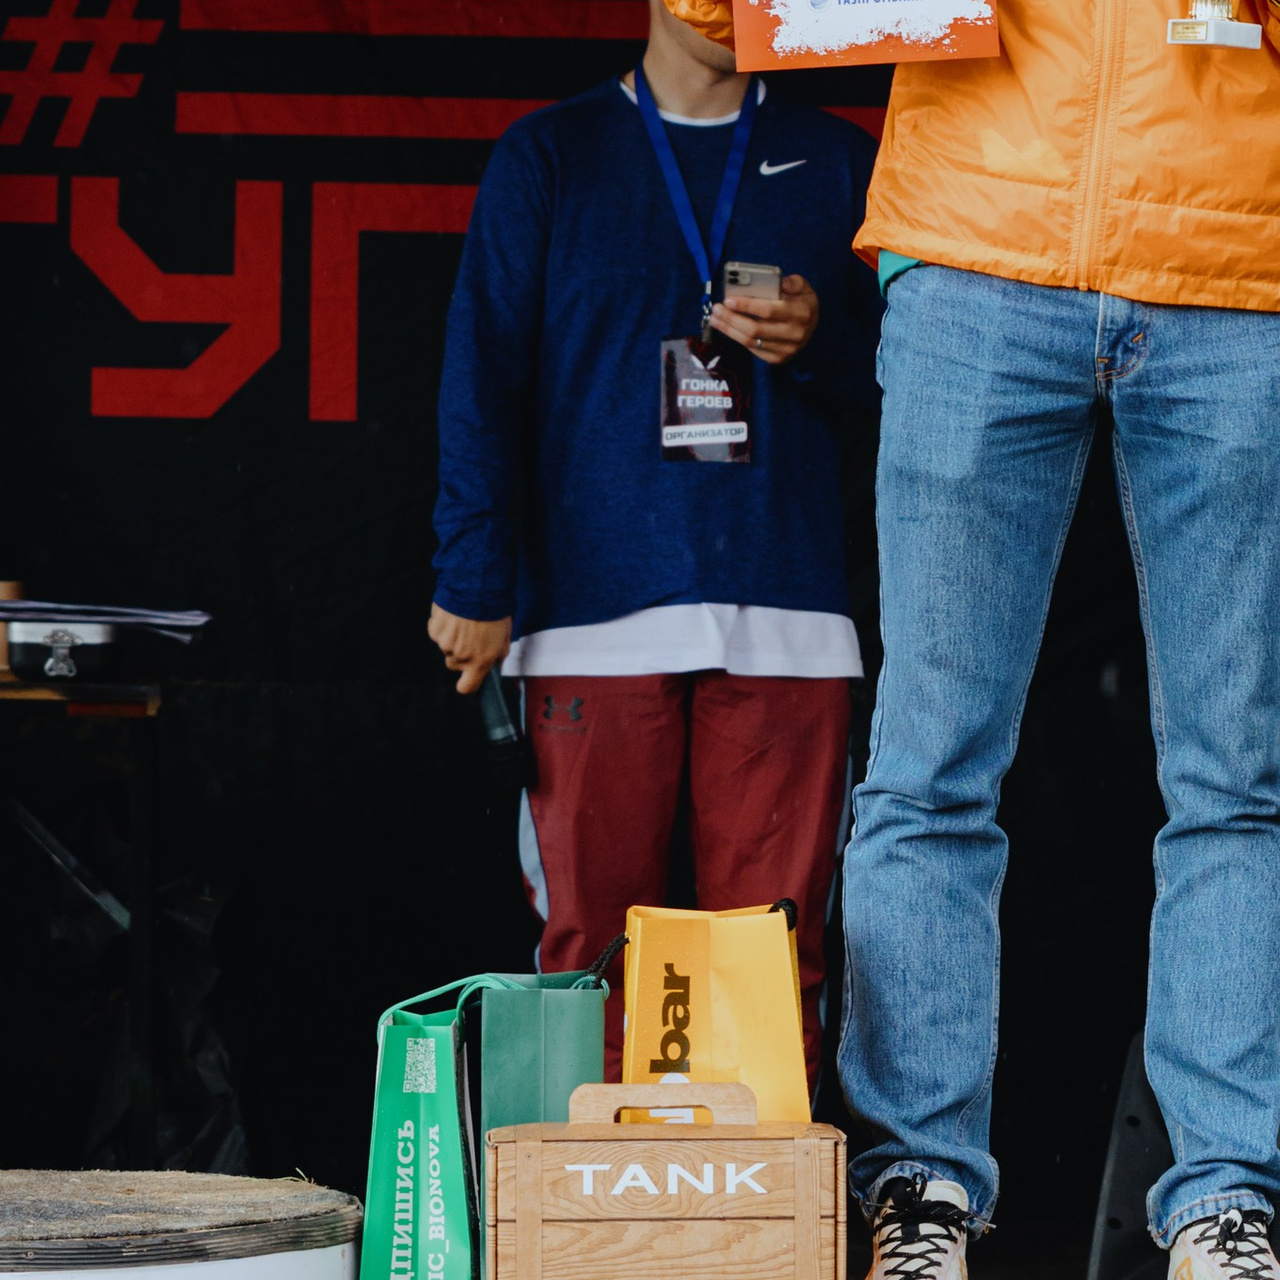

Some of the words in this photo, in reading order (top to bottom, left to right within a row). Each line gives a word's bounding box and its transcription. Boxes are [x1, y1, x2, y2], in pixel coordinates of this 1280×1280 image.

[682, 379, 729, 391] ГОНКА
[677, 395, 732, 408] ГЕРОЕВ
[665, 428, 744, 440] ОРГАНИЗАТОР
[564, 1162, 768, 1195] TANK
